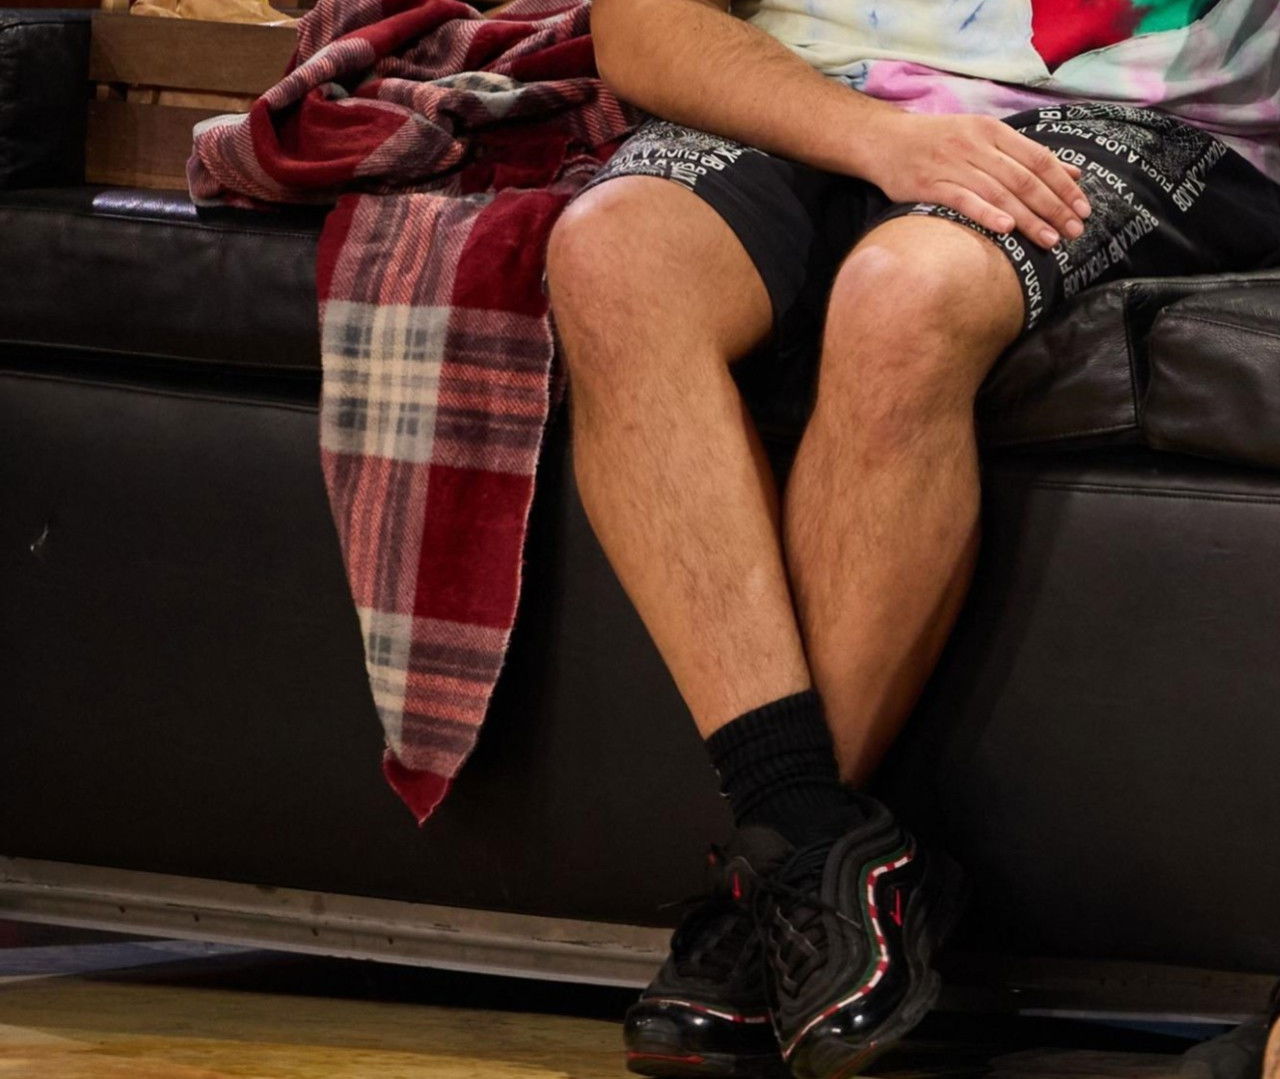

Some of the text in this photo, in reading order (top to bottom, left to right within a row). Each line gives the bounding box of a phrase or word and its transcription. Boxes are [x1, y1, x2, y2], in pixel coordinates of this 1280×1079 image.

[1048, 123, 1093, 139] FUCK
[1095, 136, 1127, 155] JOB
[1127, 151, 1140, 163] A
[1087, 161, 1128, 194] FUCK
[1123, 192, 1135, 205] A
[997, 232, 1026, 262] JOB
[1020, 260, 1043, 309] FUCK
[1051, 243, 1073, 275] FUC
